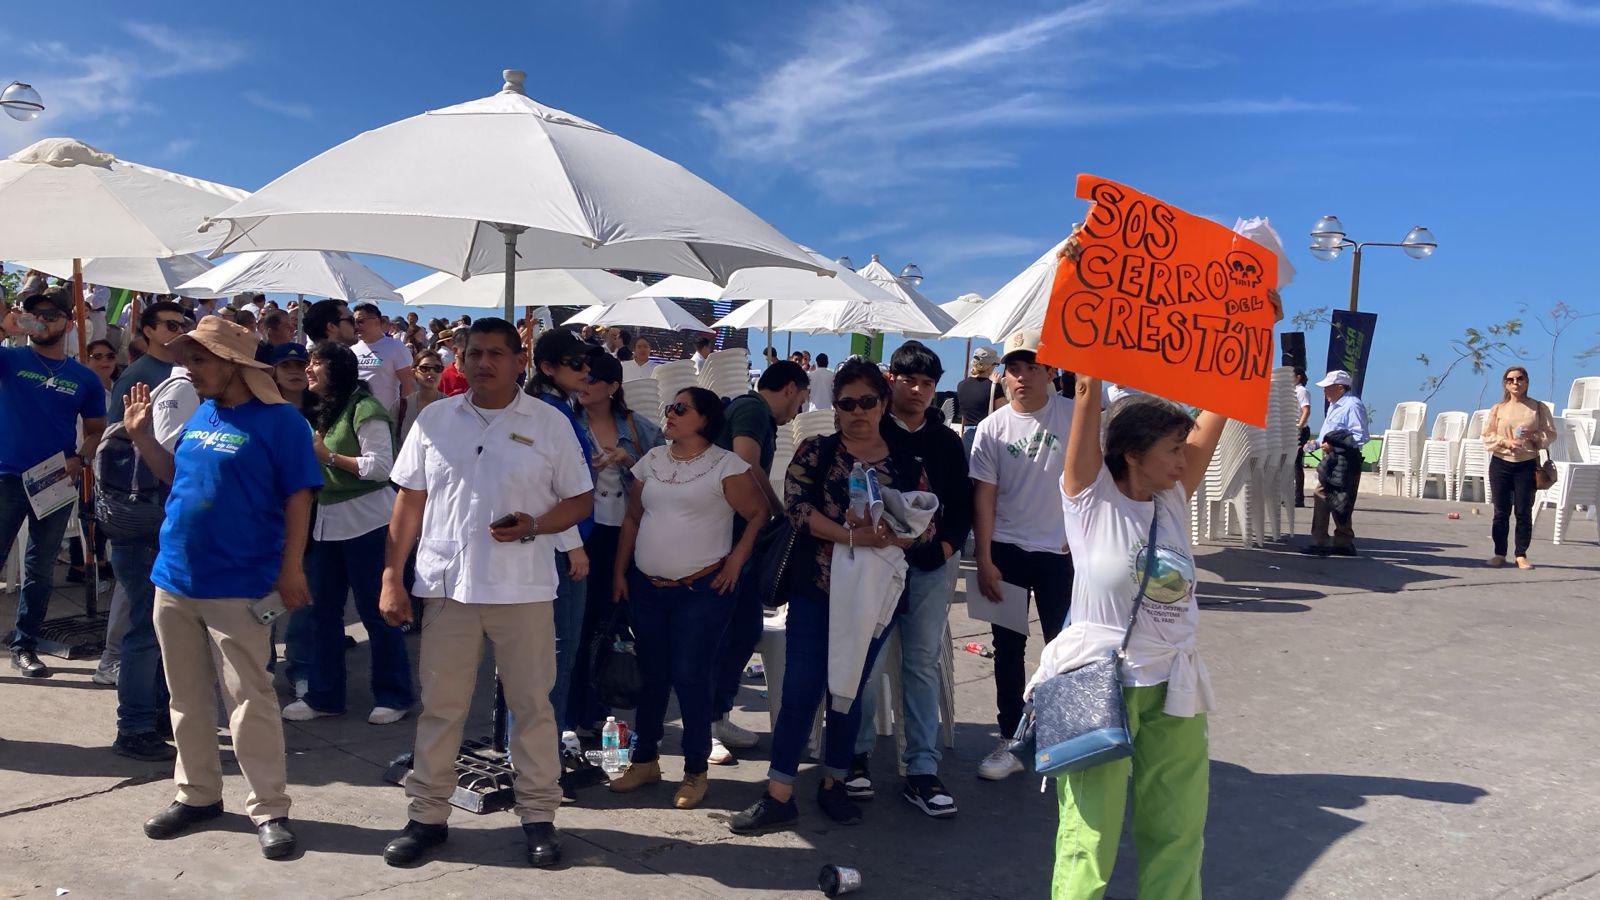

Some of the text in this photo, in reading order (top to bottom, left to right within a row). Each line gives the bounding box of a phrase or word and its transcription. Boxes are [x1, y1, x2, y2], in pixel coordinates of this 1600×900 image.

[1084, 183, 1177, 260] SOS
[1076, 245, 1228, 306] CERRO
[1225, 296, 1263, 315] DEL
[1061, 291, 1271, 380] CRESTÓN
